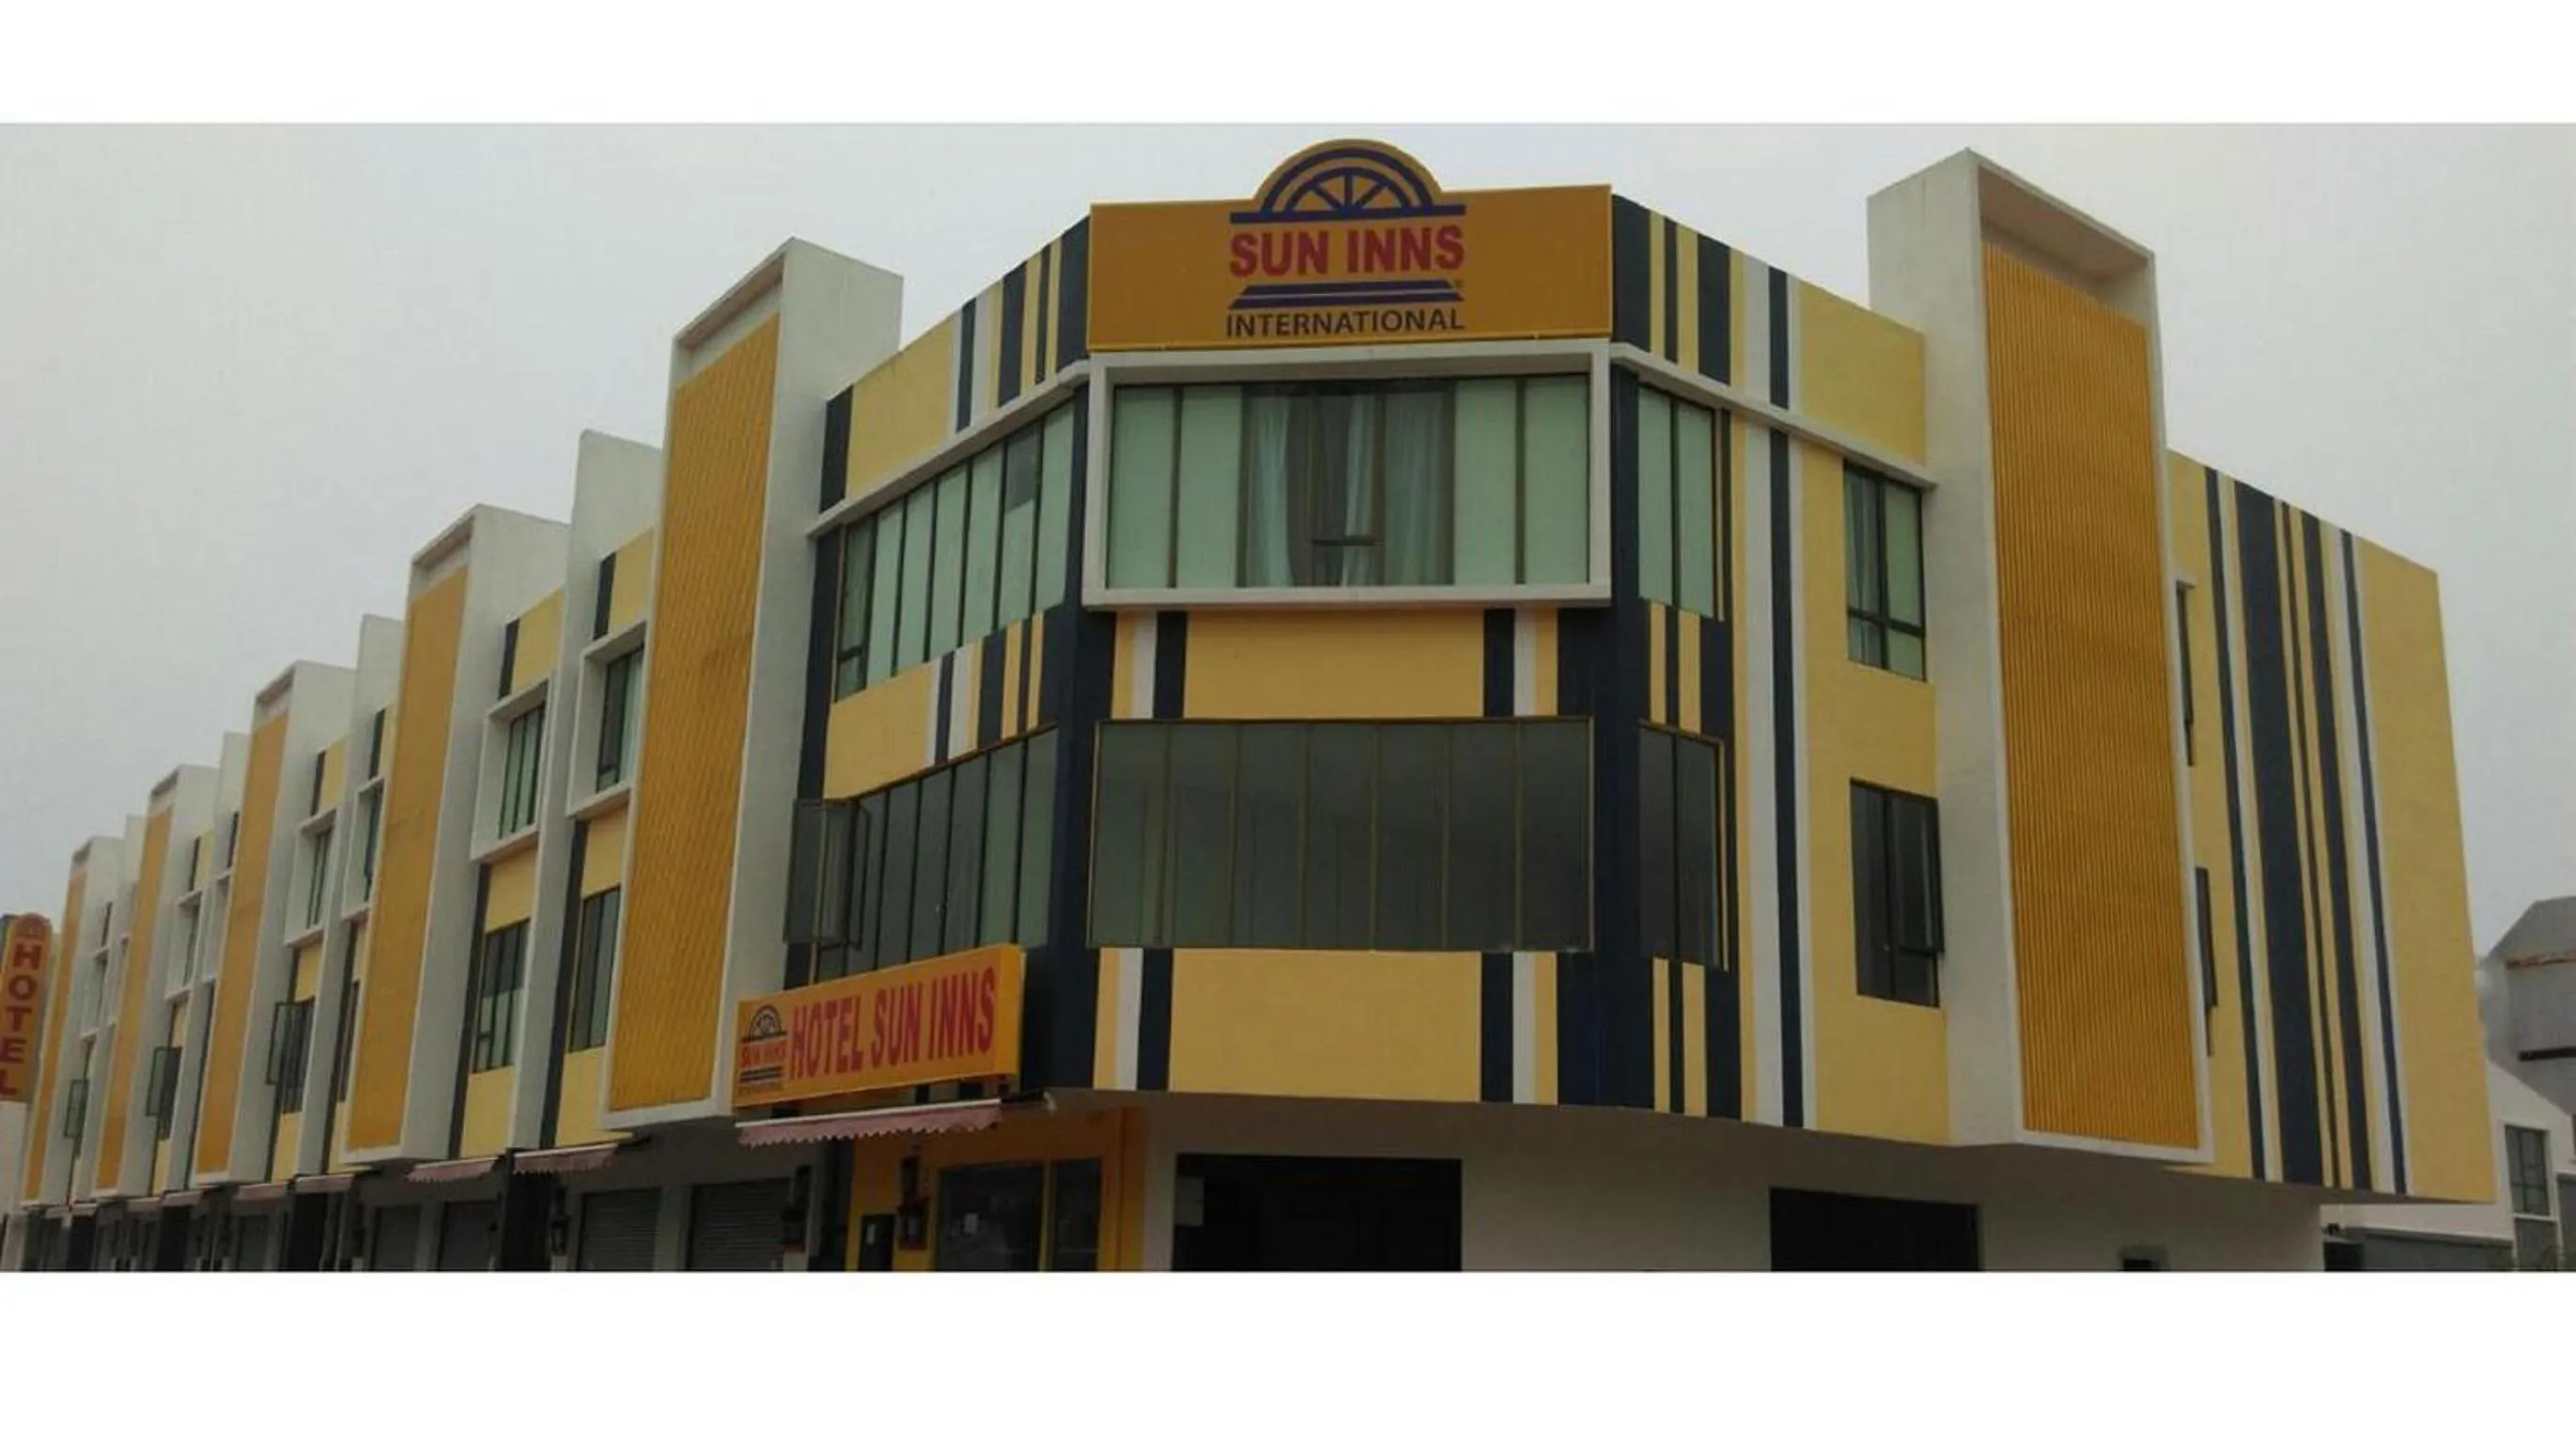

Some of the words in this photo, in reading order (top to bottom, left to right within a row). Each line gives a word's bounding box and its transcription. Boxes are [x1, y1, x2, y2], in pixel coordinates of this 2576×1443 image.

[1229, 229, 1329, 277] SUN
[1347, 225, 1466, 273] INNS
[1227, 308, 1465, 337] INTERNATIONAL
[0, 944, 41, 1095] HOTEL
[790, 998, 864, 1079] HOTEL
[870, 983, 923, 1070] SUN
[929, 967, 999, 1060] INNS
